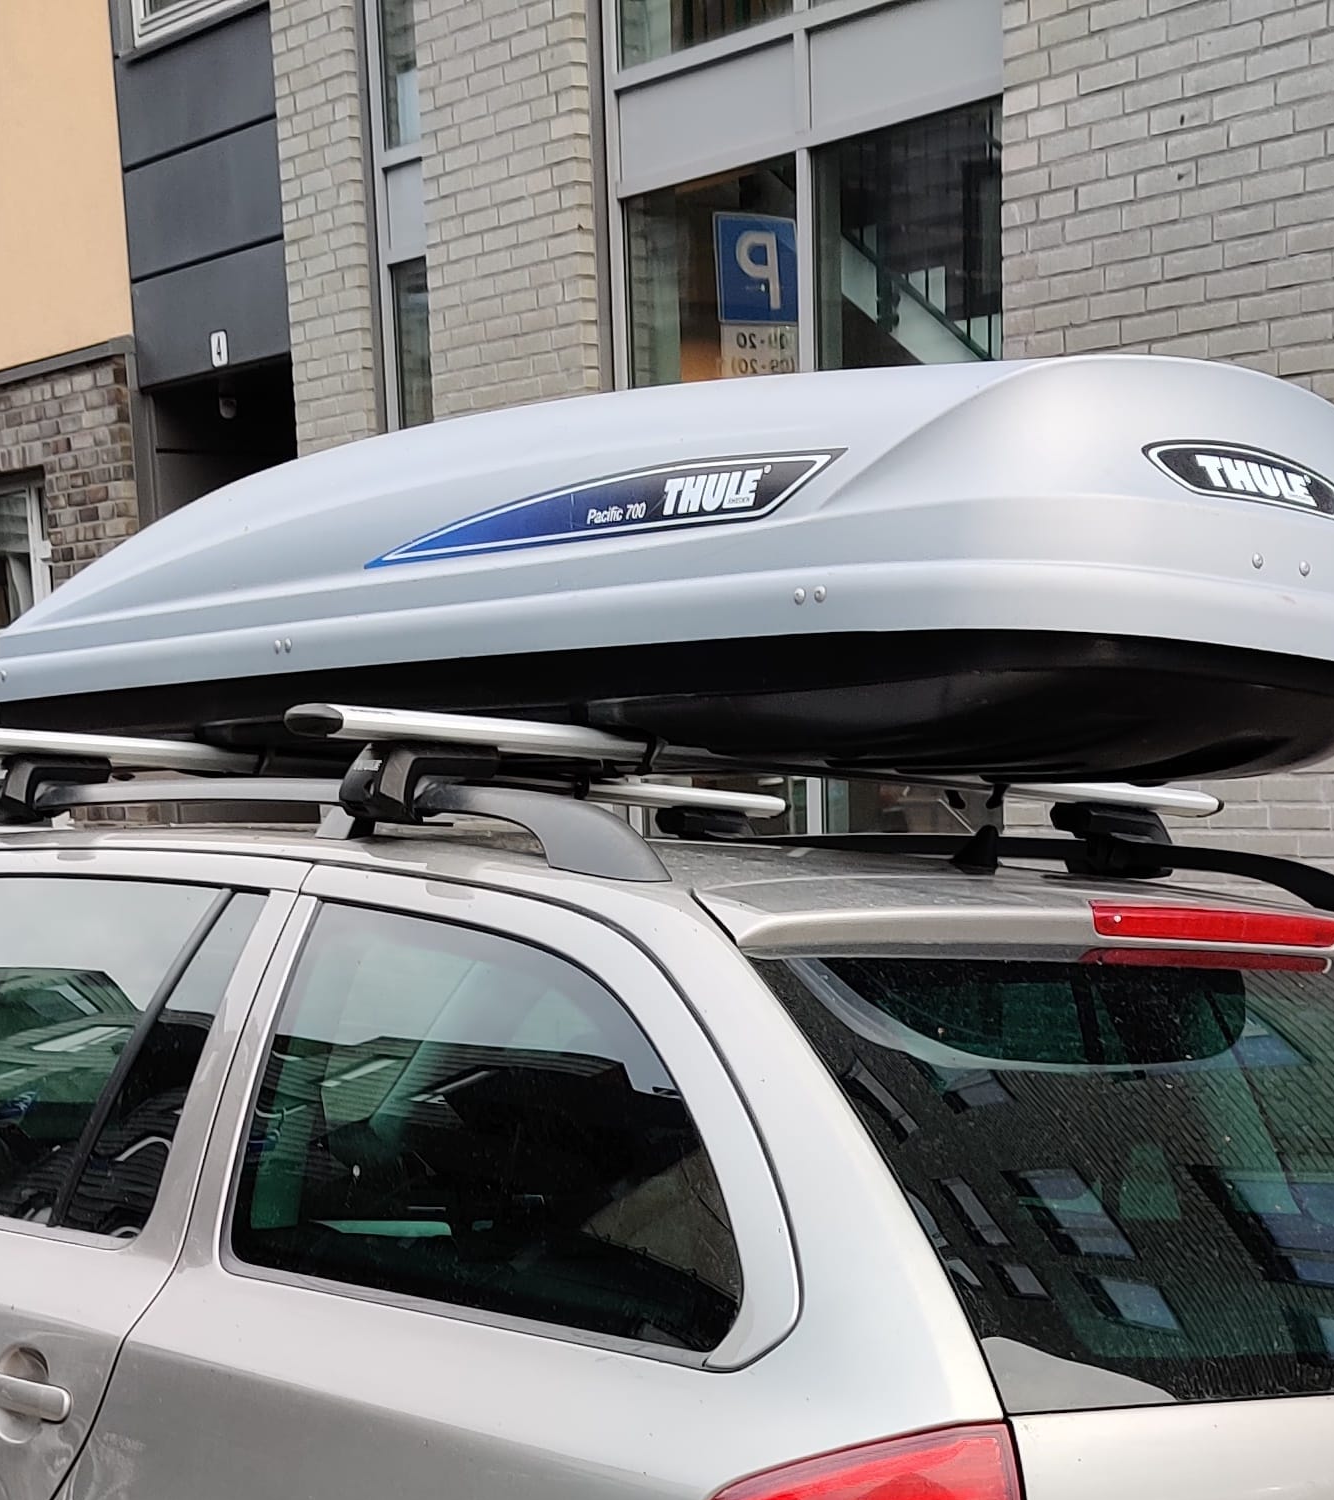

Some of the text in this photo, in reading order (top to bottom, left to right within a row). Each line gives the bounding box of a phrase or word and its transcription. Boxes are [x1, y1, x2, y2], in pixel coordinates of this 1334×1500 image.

[586, 468, 764, 525] Pacific 700 THULE
[1194, 454, 1318, 507] THULE
